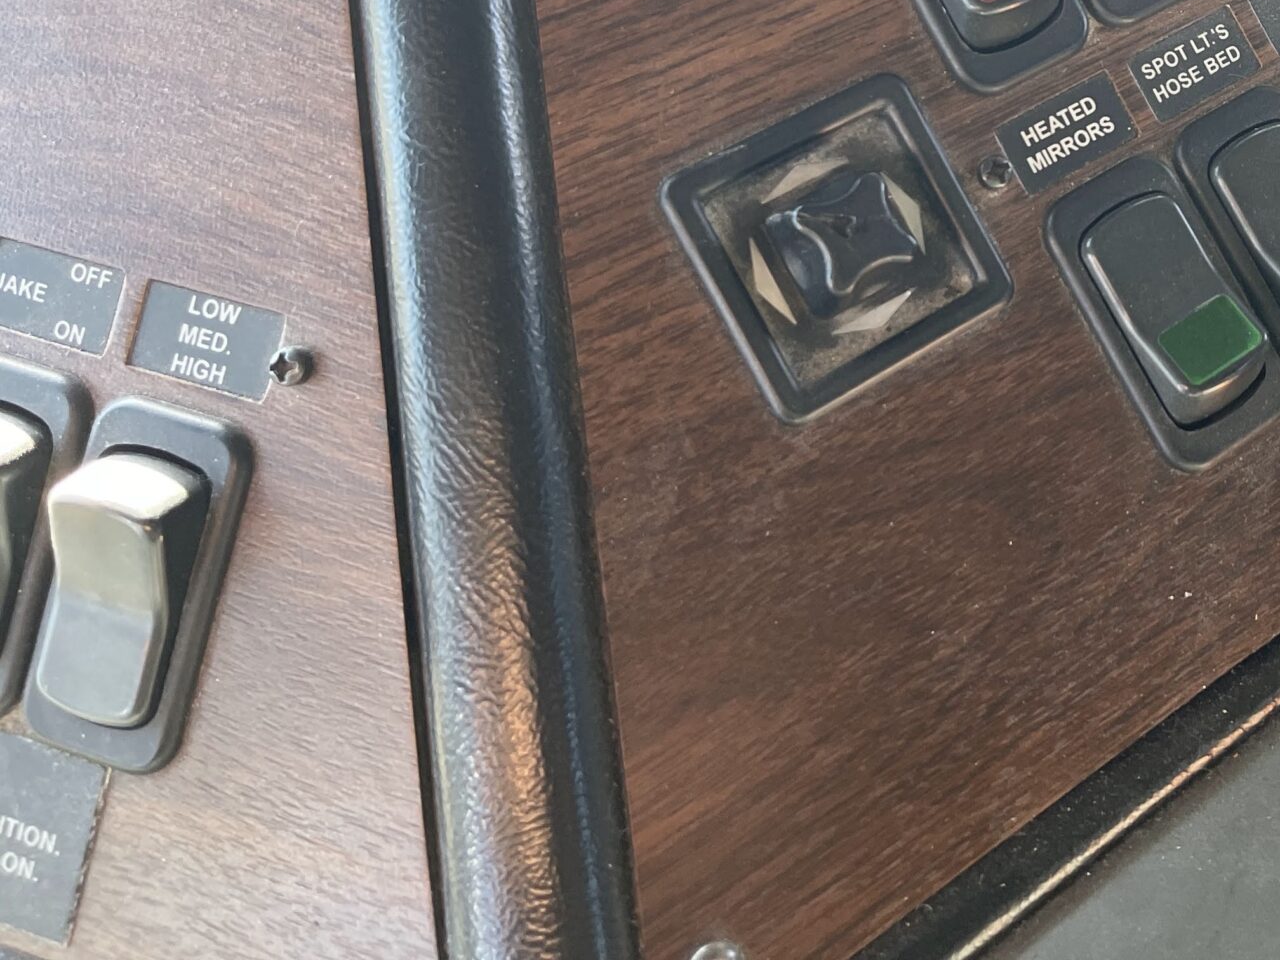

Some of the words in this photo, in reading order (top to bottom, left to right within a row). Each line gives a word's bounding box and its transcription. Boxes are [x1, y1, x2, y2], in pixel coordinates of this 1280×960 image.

[1140, 44, 1189, 80] SPOT
[1152, 65, 1204, 103] HOSE
[1203, 45, 1241, 75] BED
[1020, 96, 1097, 147] HEATED
[1026, 115, 1115, 174] MIRRORS
[71, 263, 113, 288] OFF
[188, 295, 242, 325] LOW
[54, 321, 86, 345] ON
[178, 324, 232, 356] MED.
[170, 353, 227, 385] HIGH
[0, 851, 38, 882] ON.
